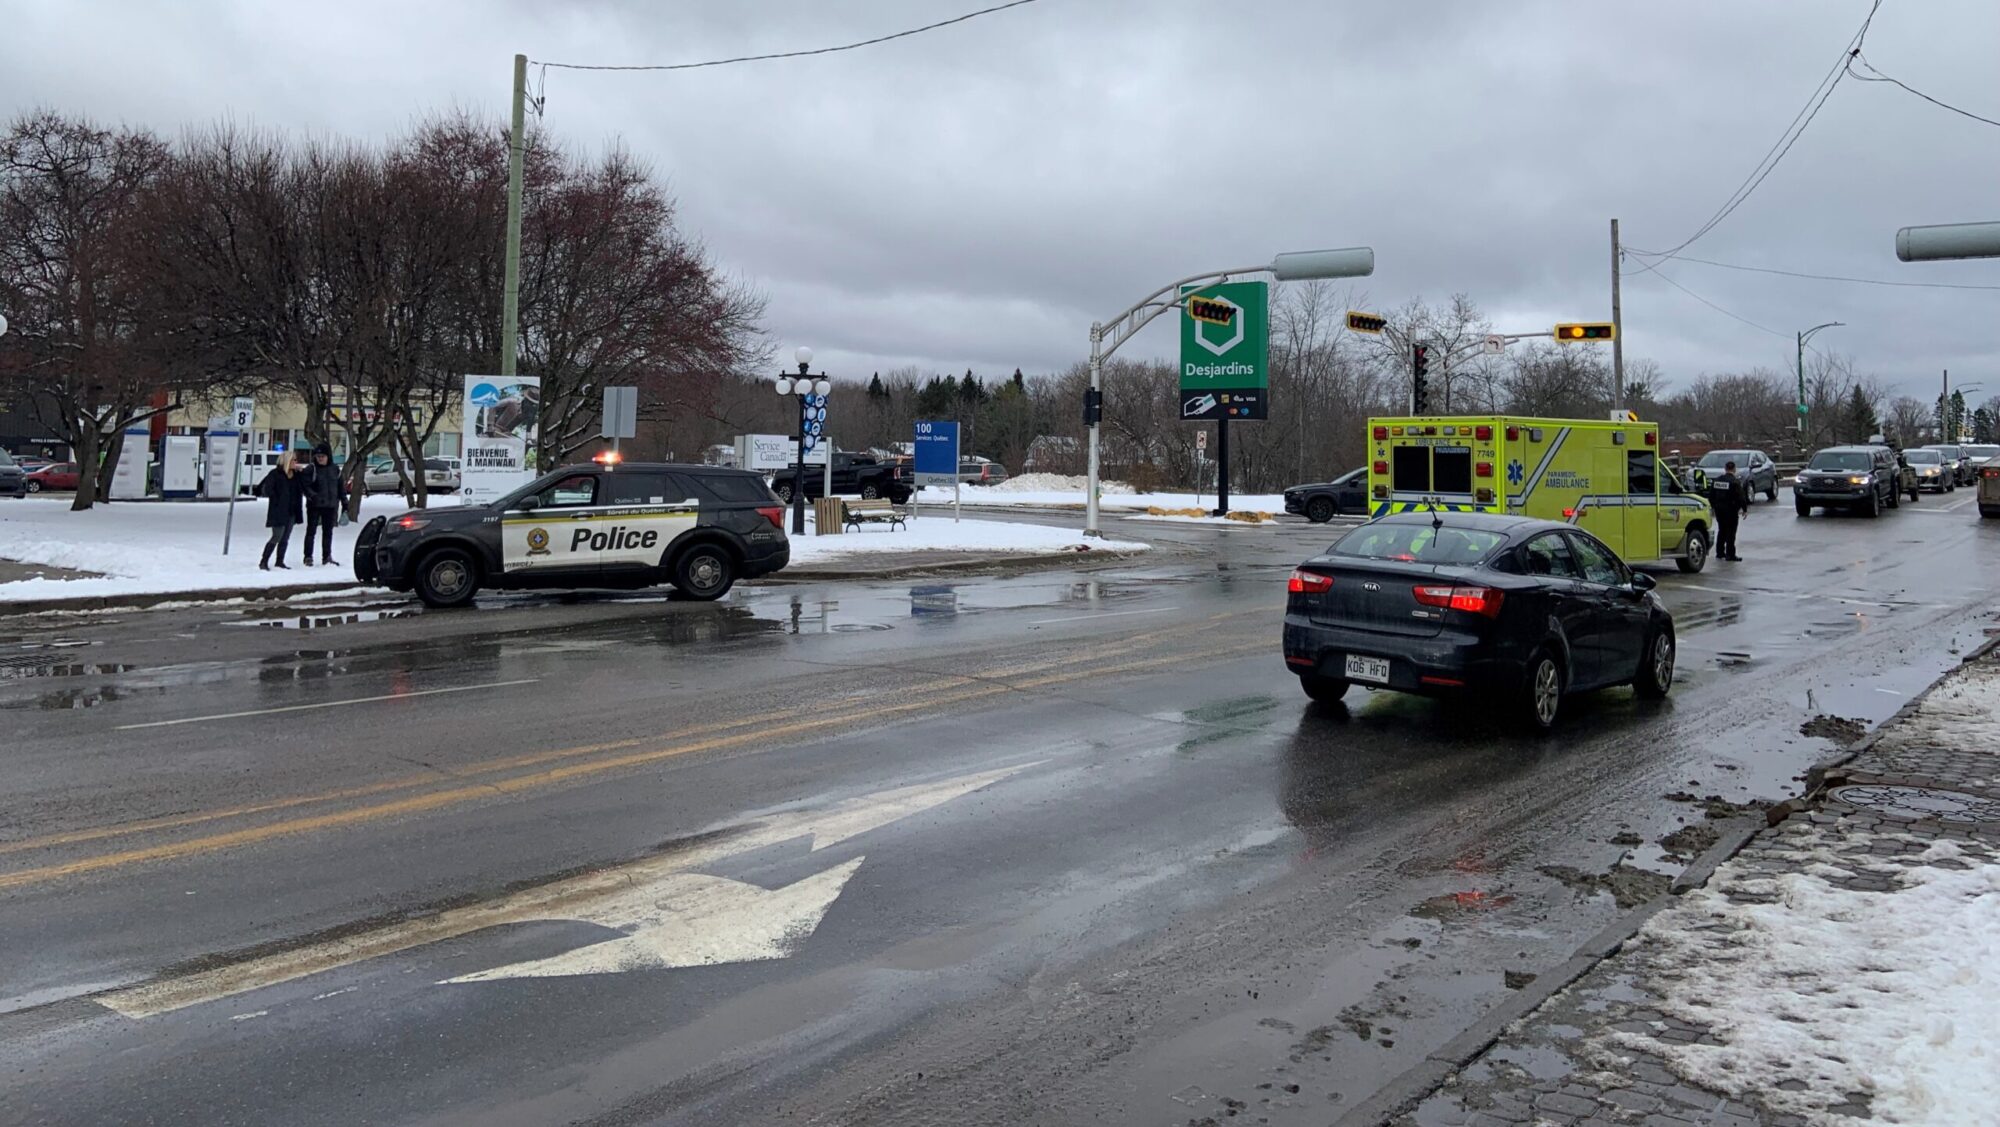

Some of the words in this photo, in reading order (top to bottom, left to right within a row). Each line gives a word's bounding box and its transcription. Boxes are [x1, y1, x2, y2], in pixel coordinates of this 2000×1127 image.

[1186, 362, 1254, 378] Desjardins
[916, 423, 932, 433] 100
[754, 439, 780, 451] Service
[467, 448, 509, 458] BIENVENUE
[761, 451, 787, 461] Canada
[475, 458, 516, 467] MANIWAKI
[1545, 478, 1590, 489] AMBULANCE
[570, 526, 658, 552] Police
[1347, 660, 1365, 673] K06
[1370, 663, 1387, 677] HFQ
